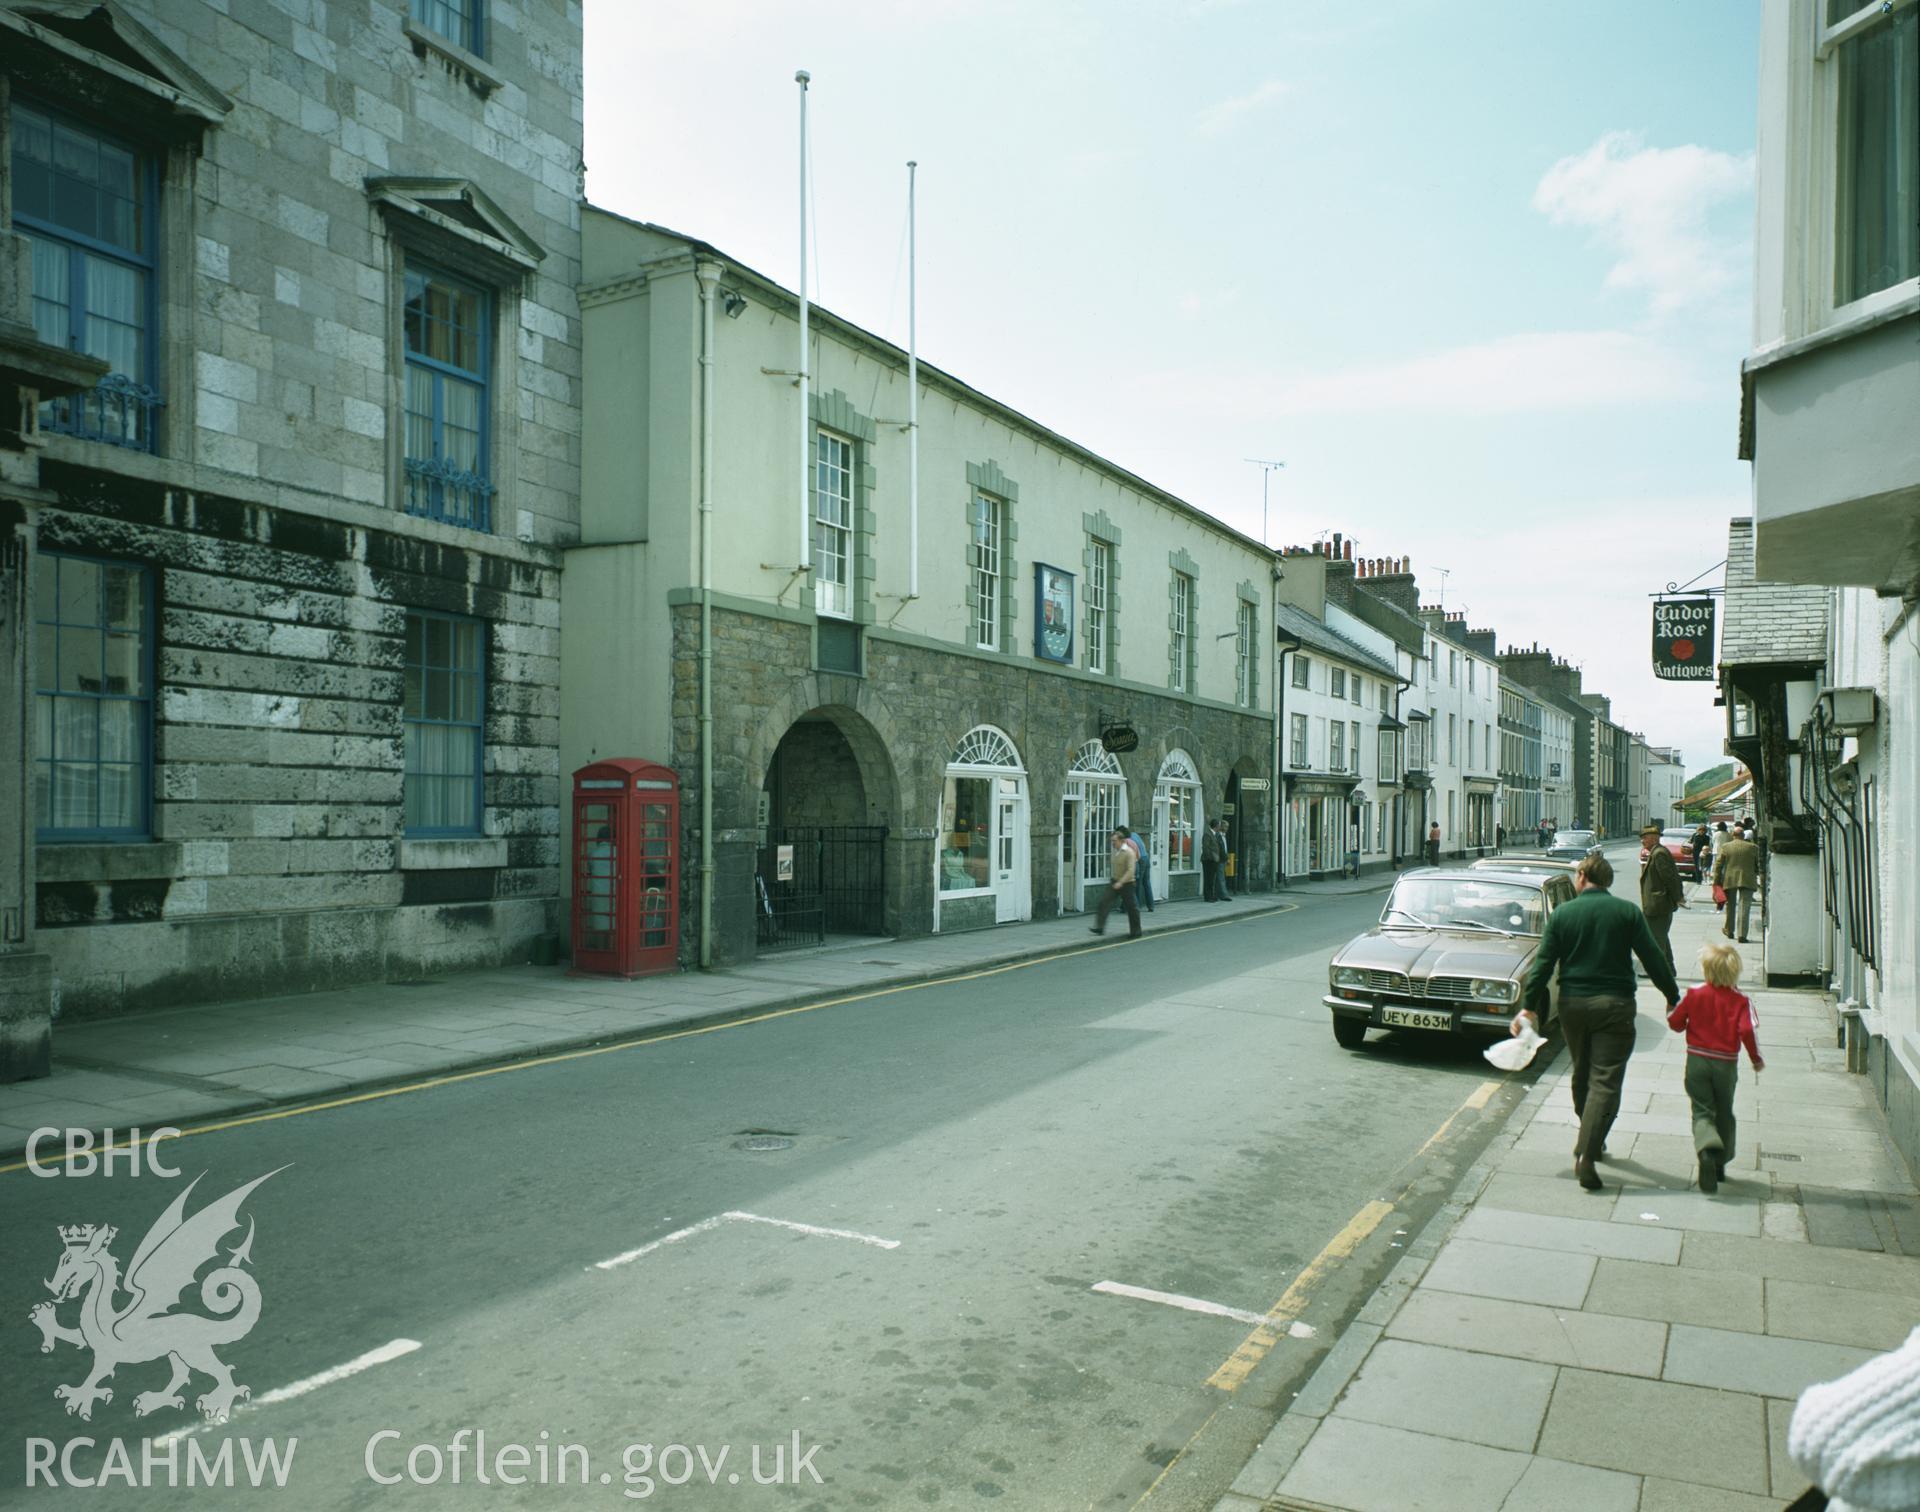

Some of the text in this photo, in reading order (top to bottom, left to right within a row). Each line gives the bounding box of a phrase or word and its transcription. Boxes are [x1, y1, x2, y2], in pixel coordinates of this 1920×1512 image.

[1655, 604, 1714, 621] Tudor
[1656, 622, 1707, 637] Rose
[1654, 660, 1713, 678] Antiques
[1382, 1010, 1451, 1029] UEY 863M
